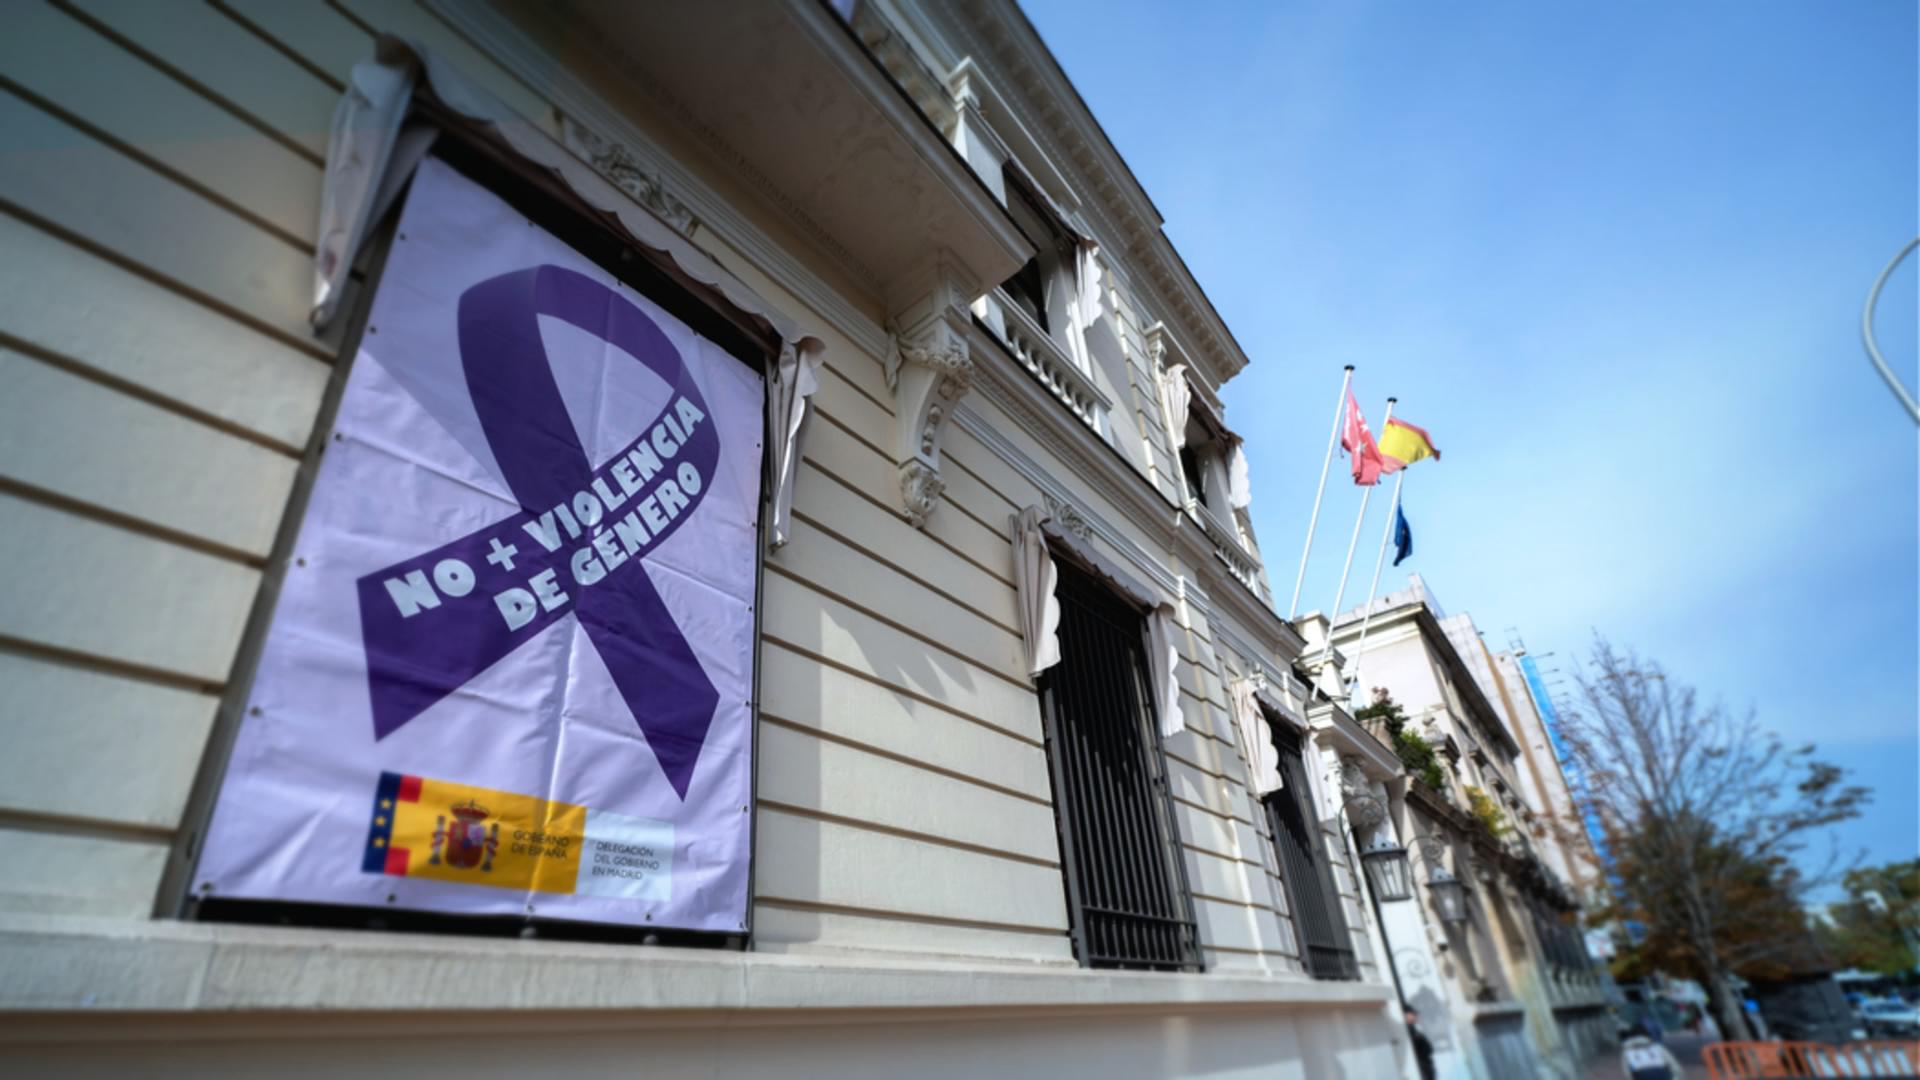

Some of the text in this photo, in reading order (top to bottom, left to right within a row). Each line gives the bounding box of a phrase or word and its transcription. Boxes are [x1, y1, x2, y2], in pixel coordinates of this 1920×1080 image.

[384, 559, 475, 618] NO
[522, 396, 705, 552] VIOLENCIA
[493, 461, 701, 632] DE GÉNERO
[511, 842, 525, 855] DE
[594, 854, 660, 870] DEL GOBIERNO
[592, 866, 643, 880] EN MADRID
